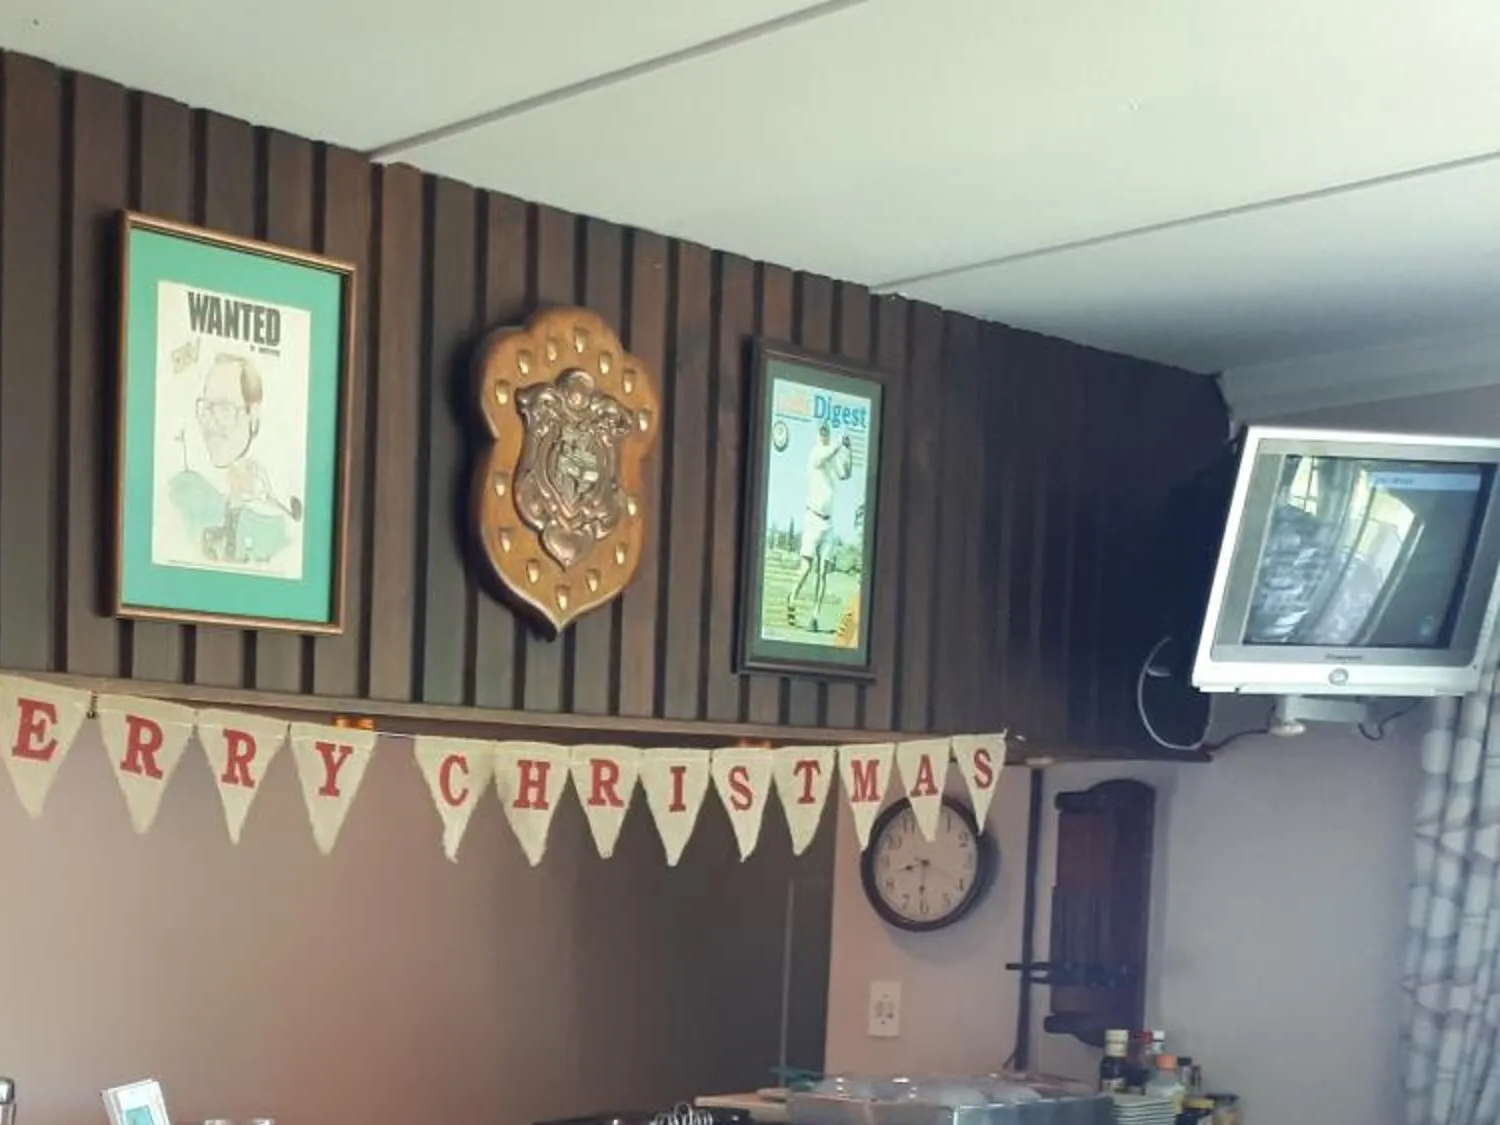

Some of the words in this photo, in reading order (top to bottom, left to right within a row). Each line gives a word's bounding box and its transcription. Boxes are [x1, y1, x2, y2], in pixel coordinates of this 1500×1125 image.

[187, 290, 281, 347] WANTED
[813, 394, 867, 429] Digest
[438, 746, 993, 811] CHRISTMAS
